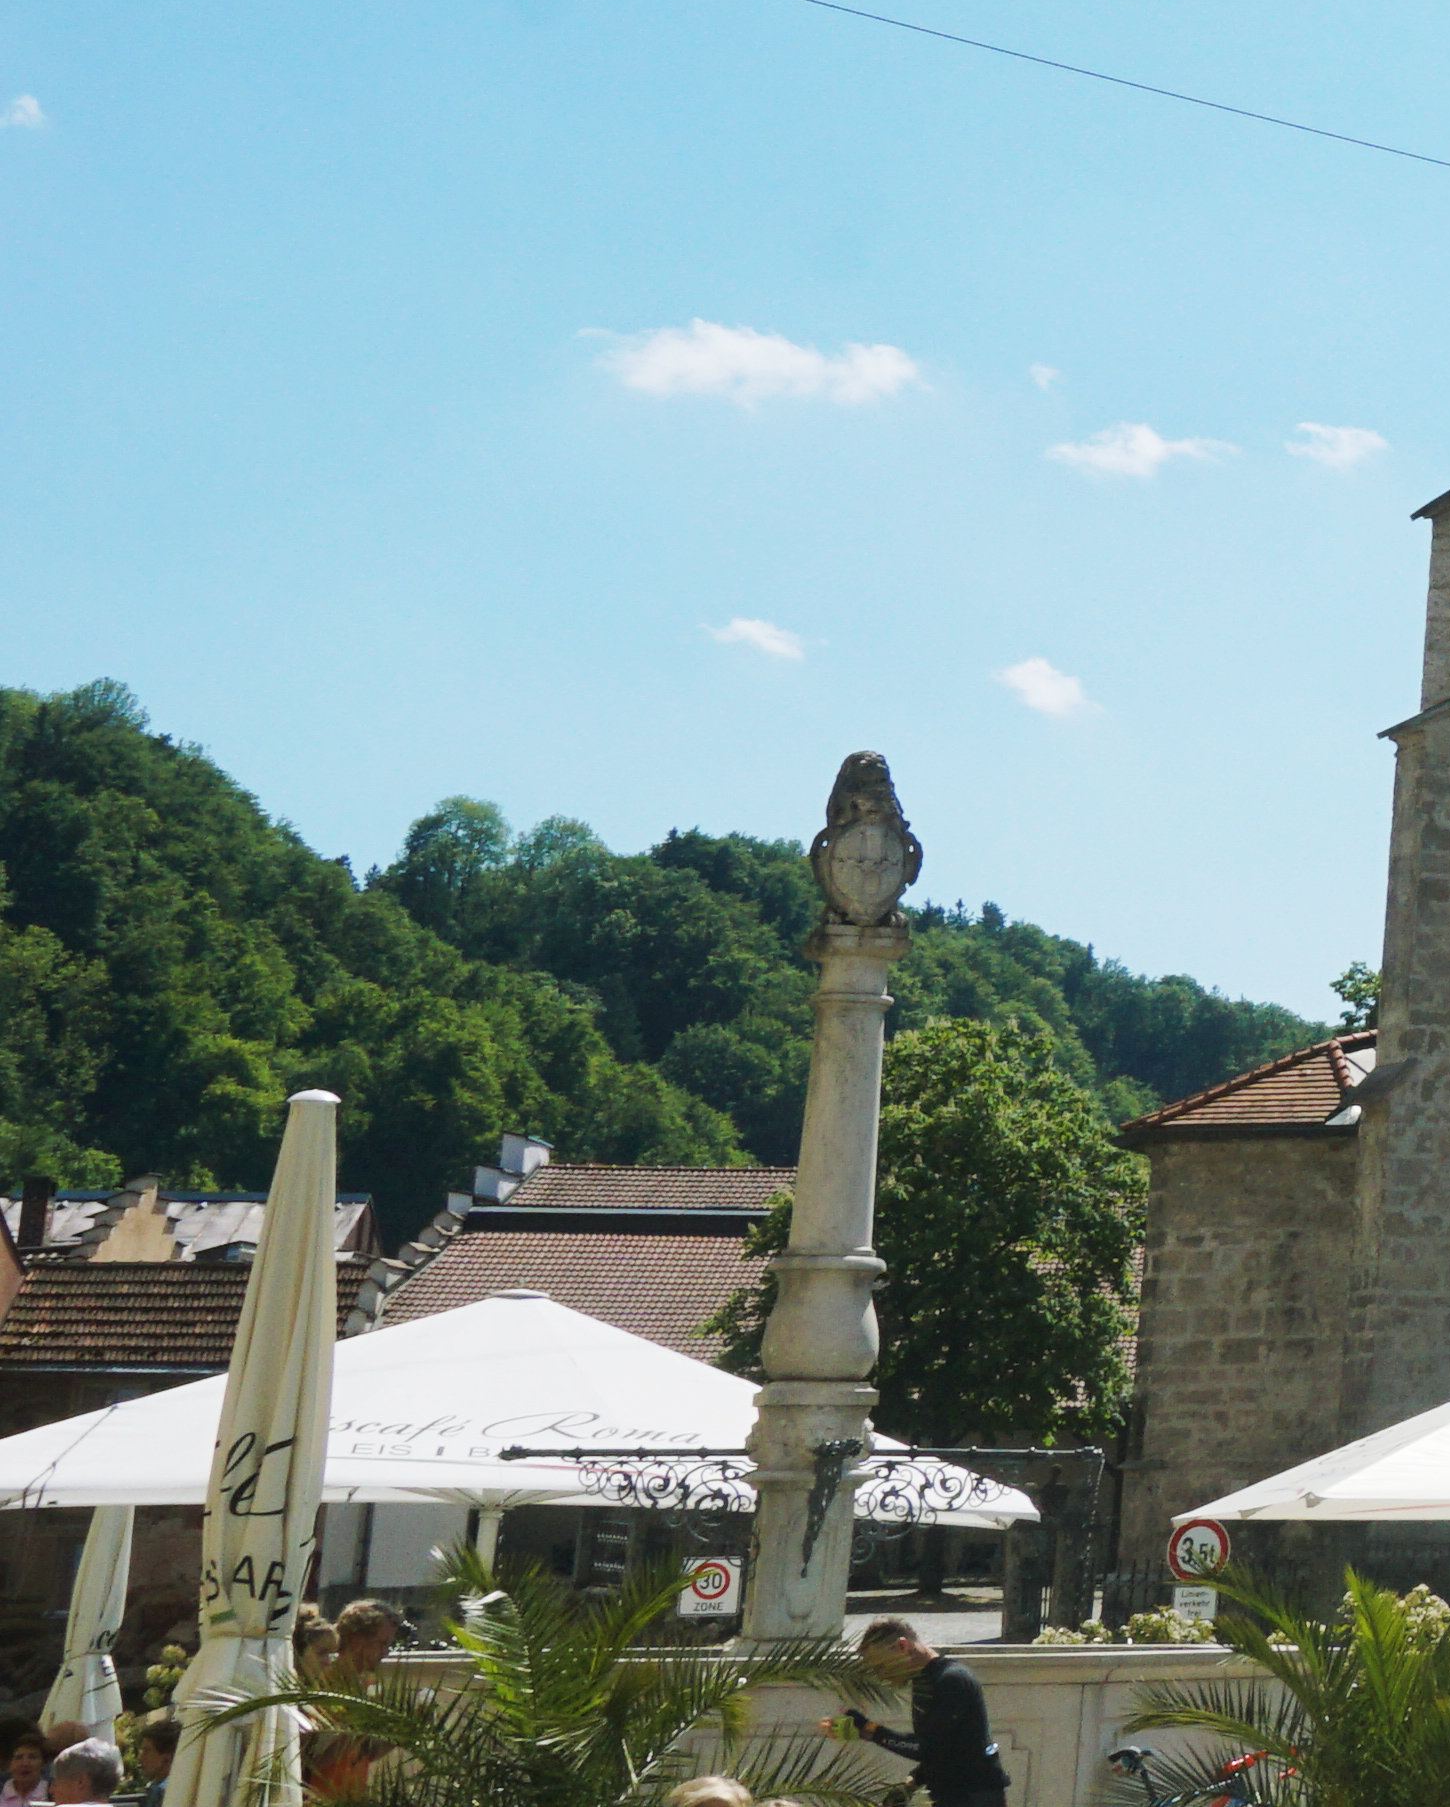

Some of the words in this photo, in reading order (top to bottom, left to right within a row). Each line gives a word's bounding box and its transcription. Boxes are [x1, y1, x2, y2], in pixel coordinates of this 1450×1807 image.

[481, 1410, 703, 1446] Roma
[351, 1442, 413, 1459] EIS
[700, 1572, 722, 1590] 30
[693, 1602, 724, 1612] ZONE
